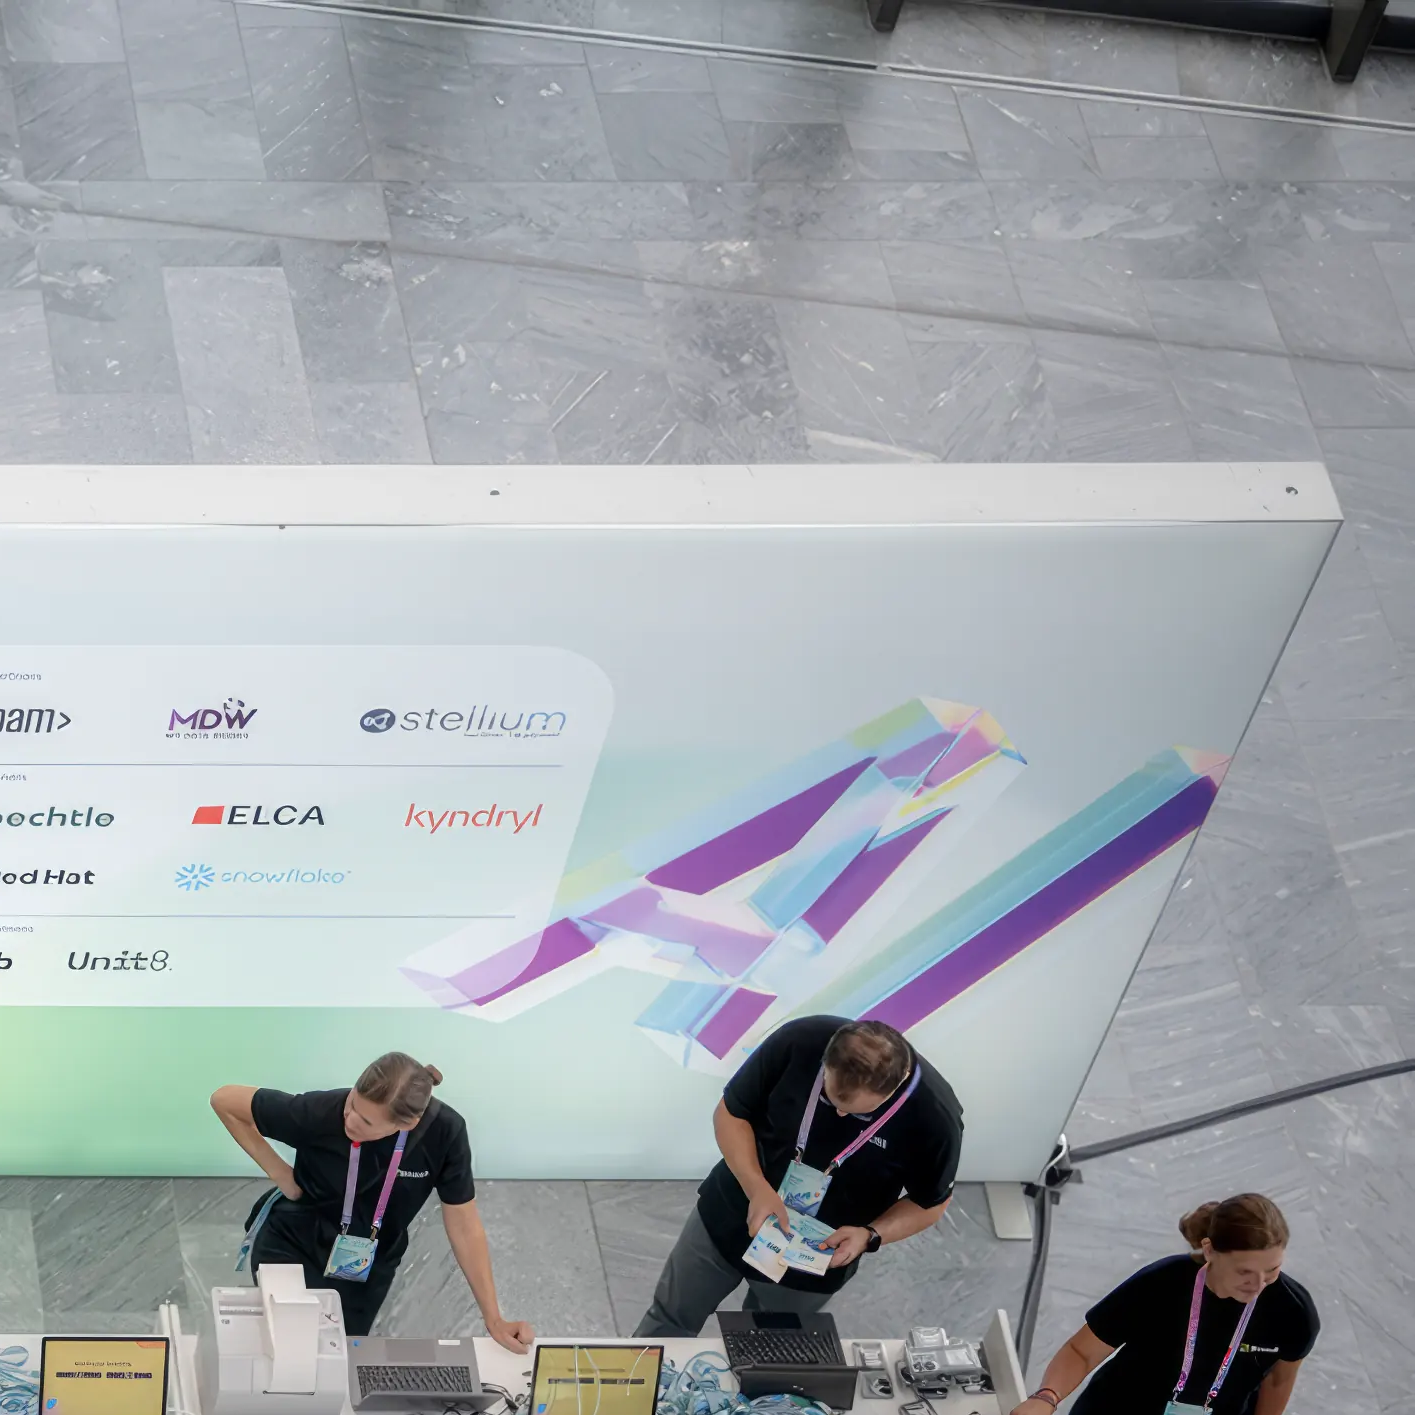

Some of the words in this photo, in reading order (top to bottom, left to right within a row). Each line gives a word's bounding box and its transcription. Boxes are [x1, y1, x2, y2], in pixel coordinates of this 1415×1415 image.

[169, 707, 257, 730] MDW
[400, 705, 566, 732] stellium
[227, 805, 324, 825] ELCA
[405, 803, 543, 834] kyndryl
